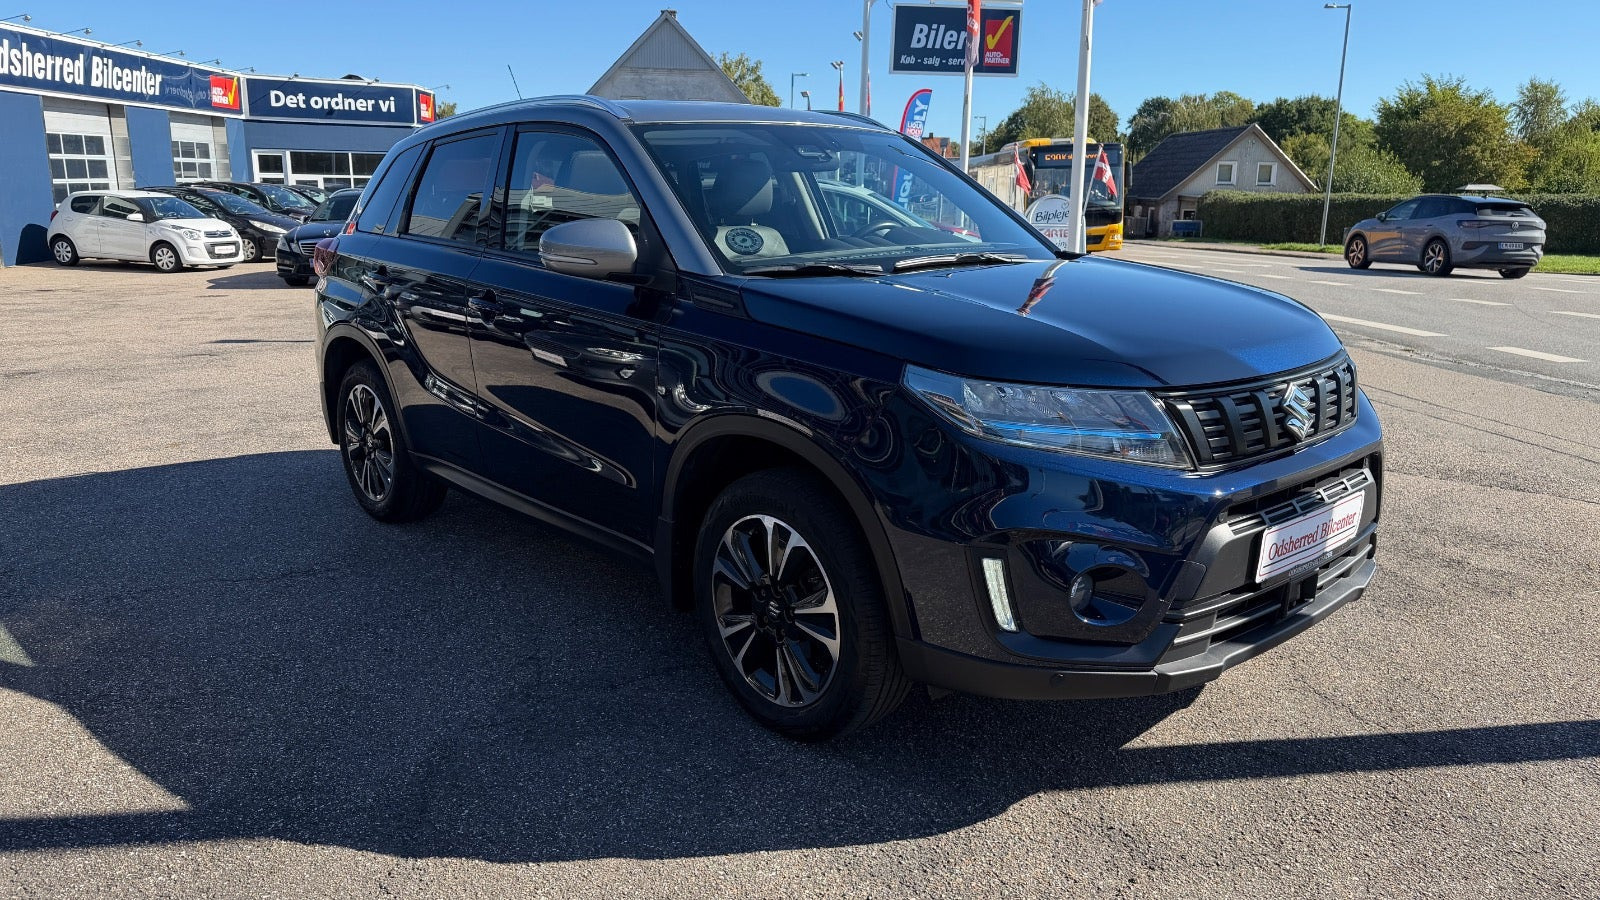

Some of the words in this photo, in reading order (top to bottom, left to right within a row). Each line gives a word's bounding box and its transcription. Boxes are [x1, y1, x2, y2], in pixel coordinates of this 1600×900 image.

[0, 38, 85, 85] dsherred
[91, 56, 162, 96] Bilcenter
[923, 55, 940, 66] salg
[948, 57, 966, 66] serv
[269, 90, 306, 109] Det
[310, 93, 375, 112] ordner
[378, 96, 396, 113] vi
[1044, 229, 1069, 238] ARTE
[1268, 524, 1320, 561] Odsherred
[1320, 512, 1357, 540] Bilcenter
